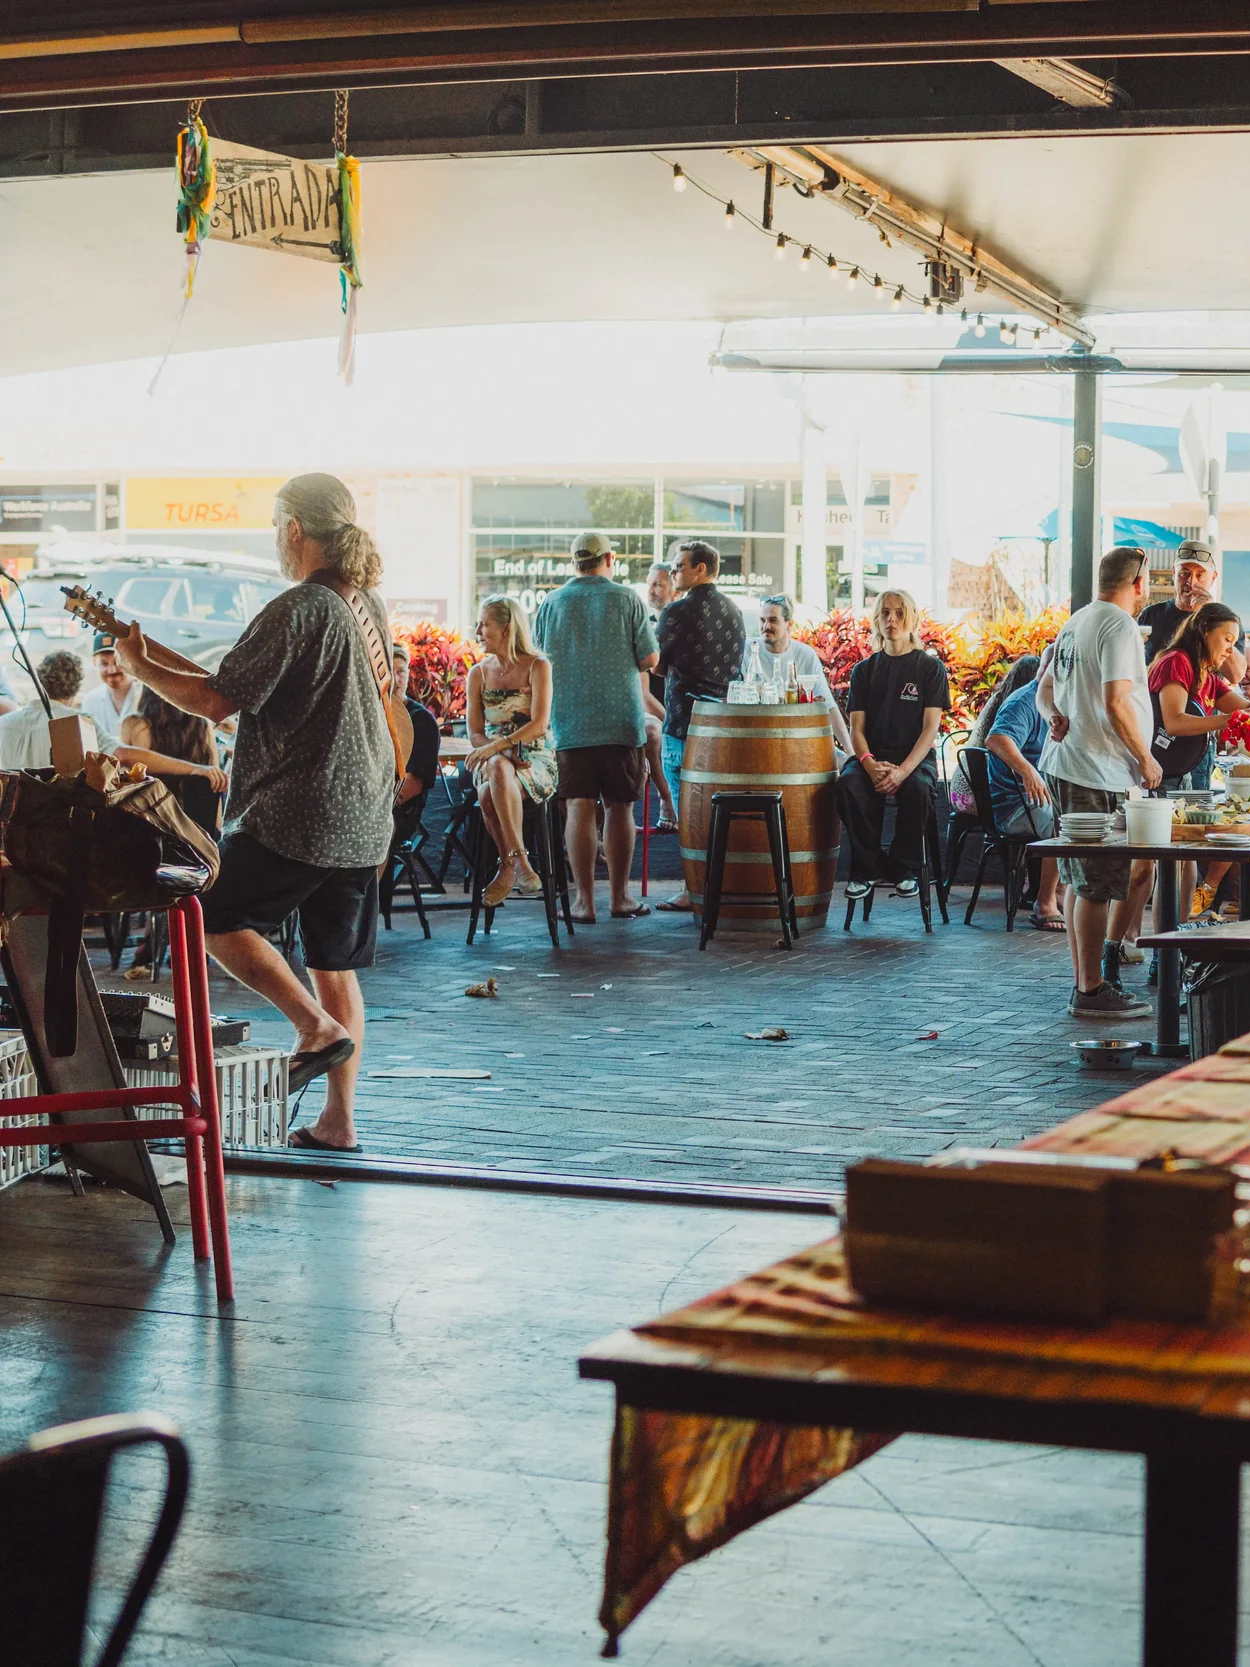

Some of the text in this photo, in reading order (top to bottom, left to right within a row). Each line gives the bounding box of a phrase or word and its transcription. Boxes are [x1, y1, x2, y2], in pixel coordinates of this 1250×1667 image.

[228, 163, 342, 239] ENTRADA
[165, 503, 239, 523] TURSA
[493, 558, 525, 576] End
[527, 558, 545, 576] of
[546, 559, 575, 576] Lea
[748, 572, 773, 586] Sale
